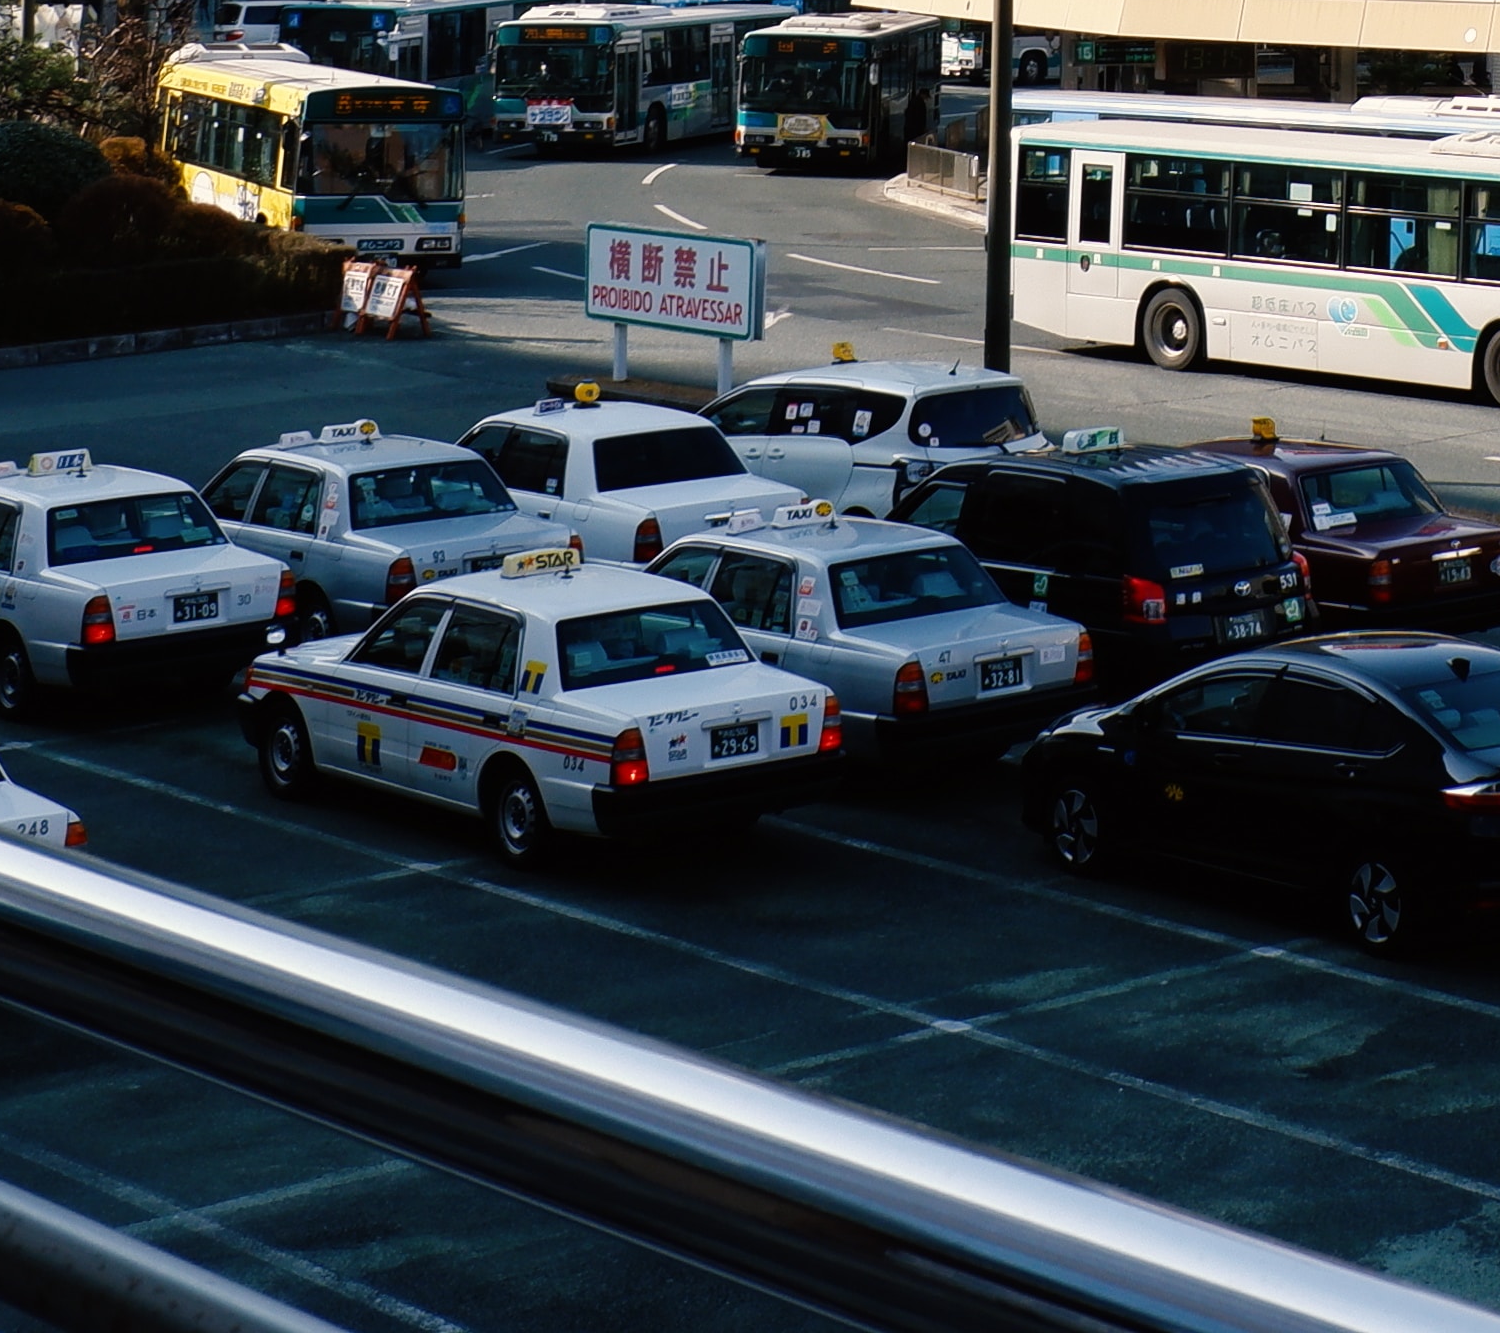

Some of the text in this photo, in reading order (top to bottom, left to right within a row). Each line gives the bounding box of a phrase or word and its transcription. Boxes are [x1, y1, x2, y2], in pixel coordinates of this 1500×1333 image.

[1077, 47, 1092, 60] 15
[608, 239, 731, 293] 横断禁止
[591, 284, 744, 325] PROIBIDO ATRAVESSAR
[1252, 296, 1317, 316] 超低床バス
[1252, 335, 1317, 353] オムニバス
[331, 427, 357, 438] TAXI
[787, 509, 812, 521] TAXI
[432, 551, 446, 564] 93
[536, 552, 574, 569] STAR
[1279, 572, 1298, 589] 531
[237, 593, 252, 607] 30
[136, 608, 157, 622] 日本
[184, 602, 217, 620] 31-09
[1233, 621, 1262, 639] 38-74
[938, 650, 951, 665] 47
[991, 668, 1021, 687] 32-81
[790, 694, 817, 711] 034
[721, 735, 757, 756] 29-69
[563, 755, 585, 773] 034
[17, 819, 49, 837] 248
